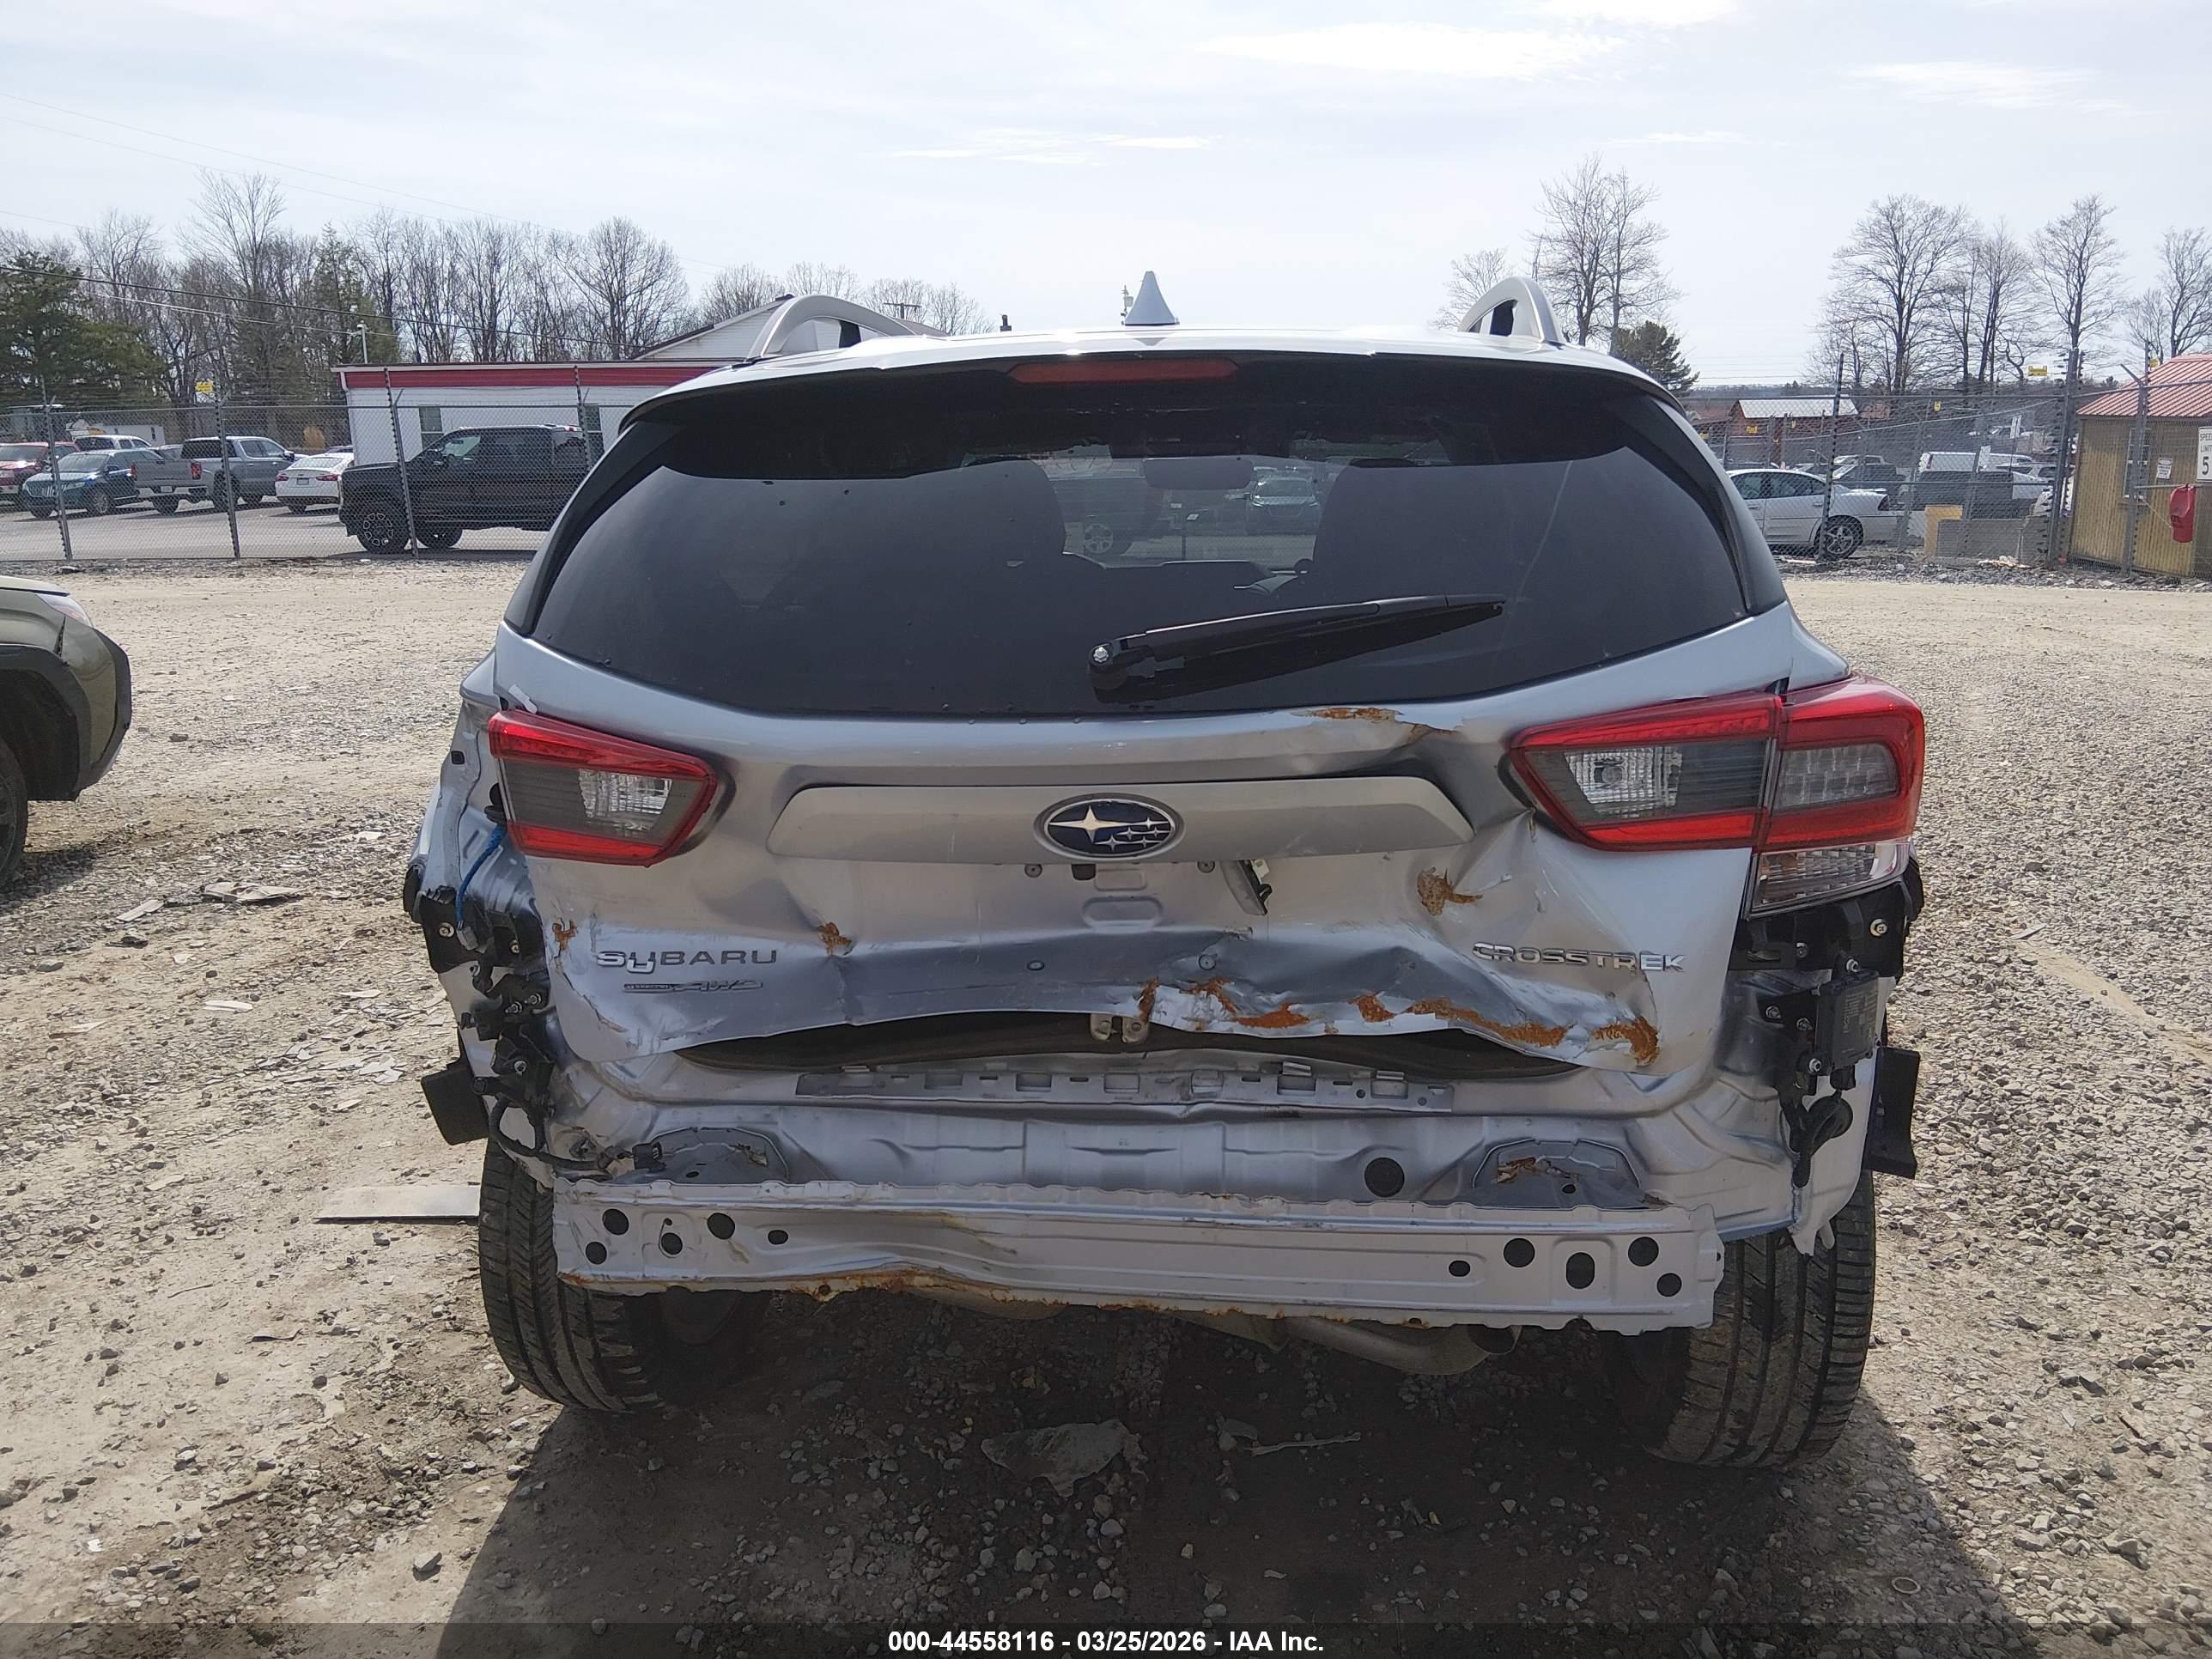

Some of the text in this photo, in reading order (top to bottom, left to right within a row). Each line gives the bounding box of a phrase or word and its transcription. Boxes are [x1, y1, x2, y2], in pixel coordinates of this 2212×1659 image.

[2199, 433, 2212, 441] SPEE
[597, 950, 777, 974] SUBARU
[1472, 941, 1688, 973] CROSSTREK
